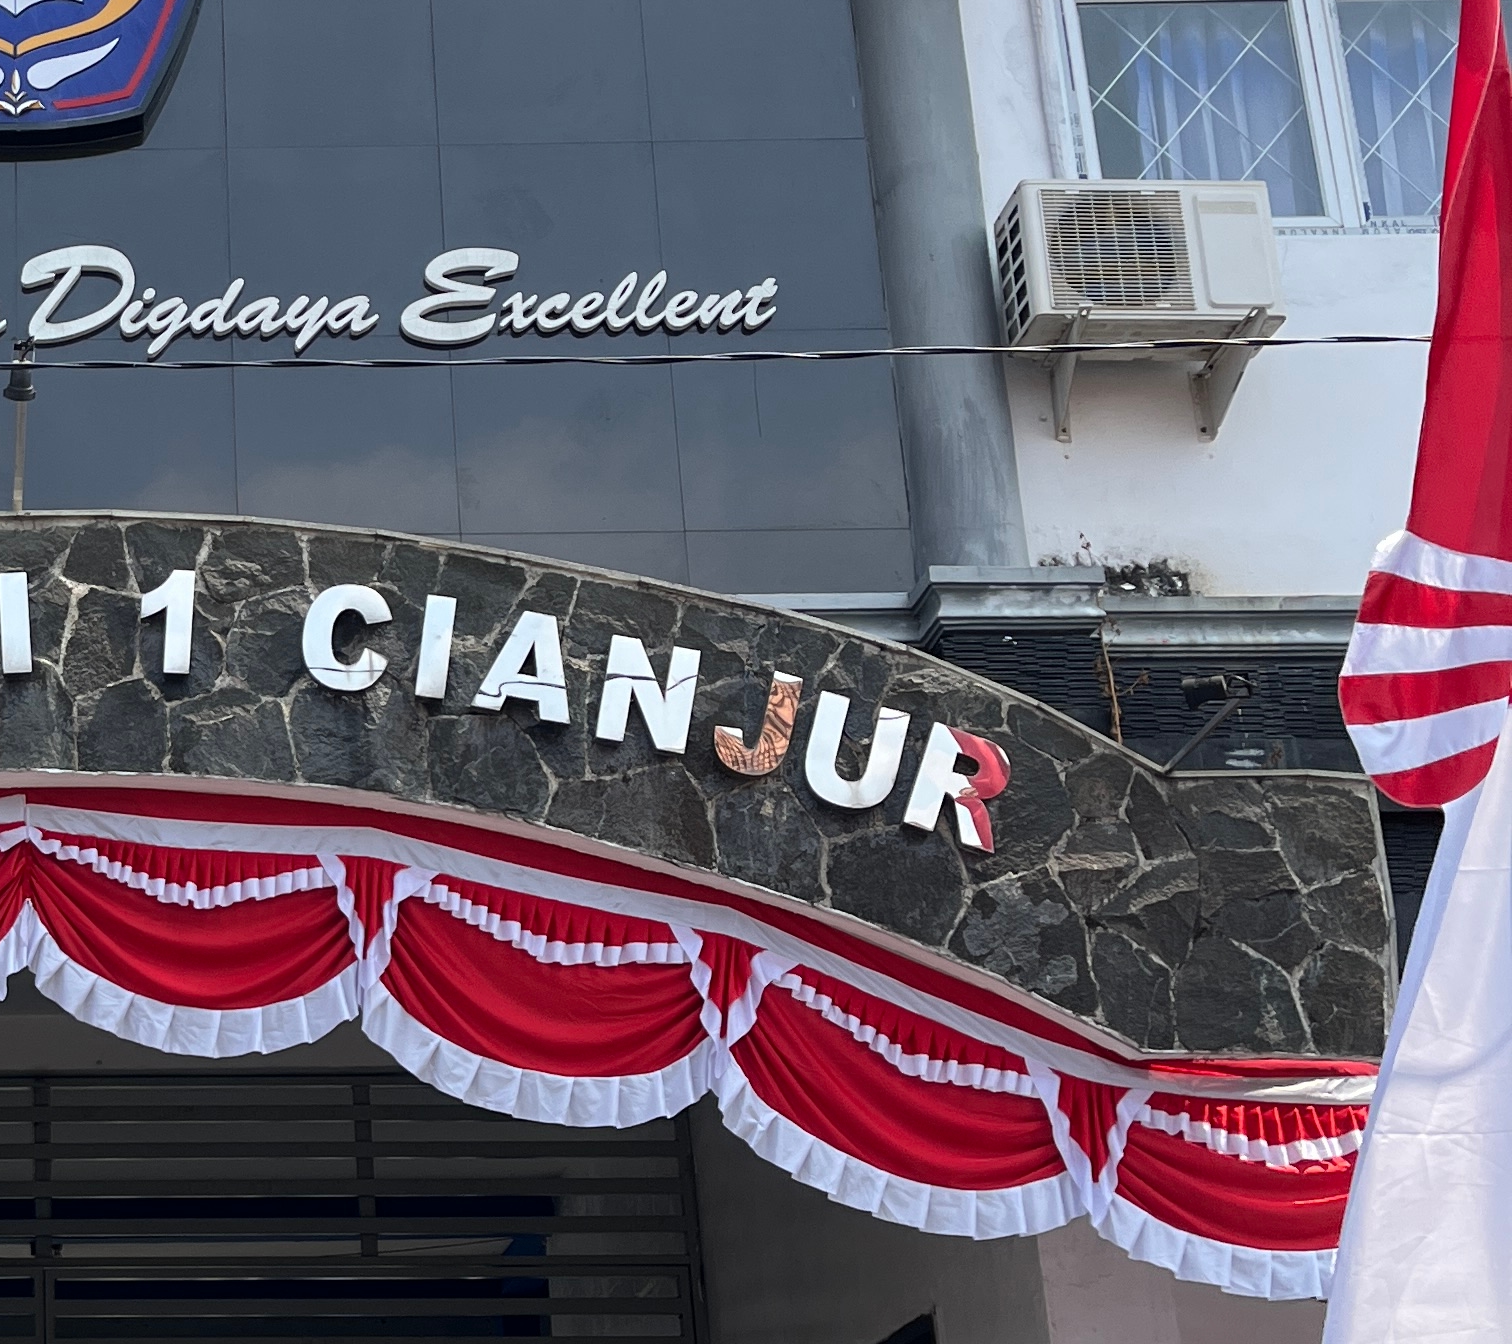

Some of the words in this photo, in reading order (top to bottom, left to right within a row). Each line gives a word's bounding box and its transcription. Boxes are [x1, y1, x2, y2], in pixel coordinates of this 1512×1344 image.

[19, 244, 381, 356] Digdaya
[399, 246, 780, 346] Excellent
[139, 568, 197, 675] 1
[300, 582, 1011, 855] CIANJUR
